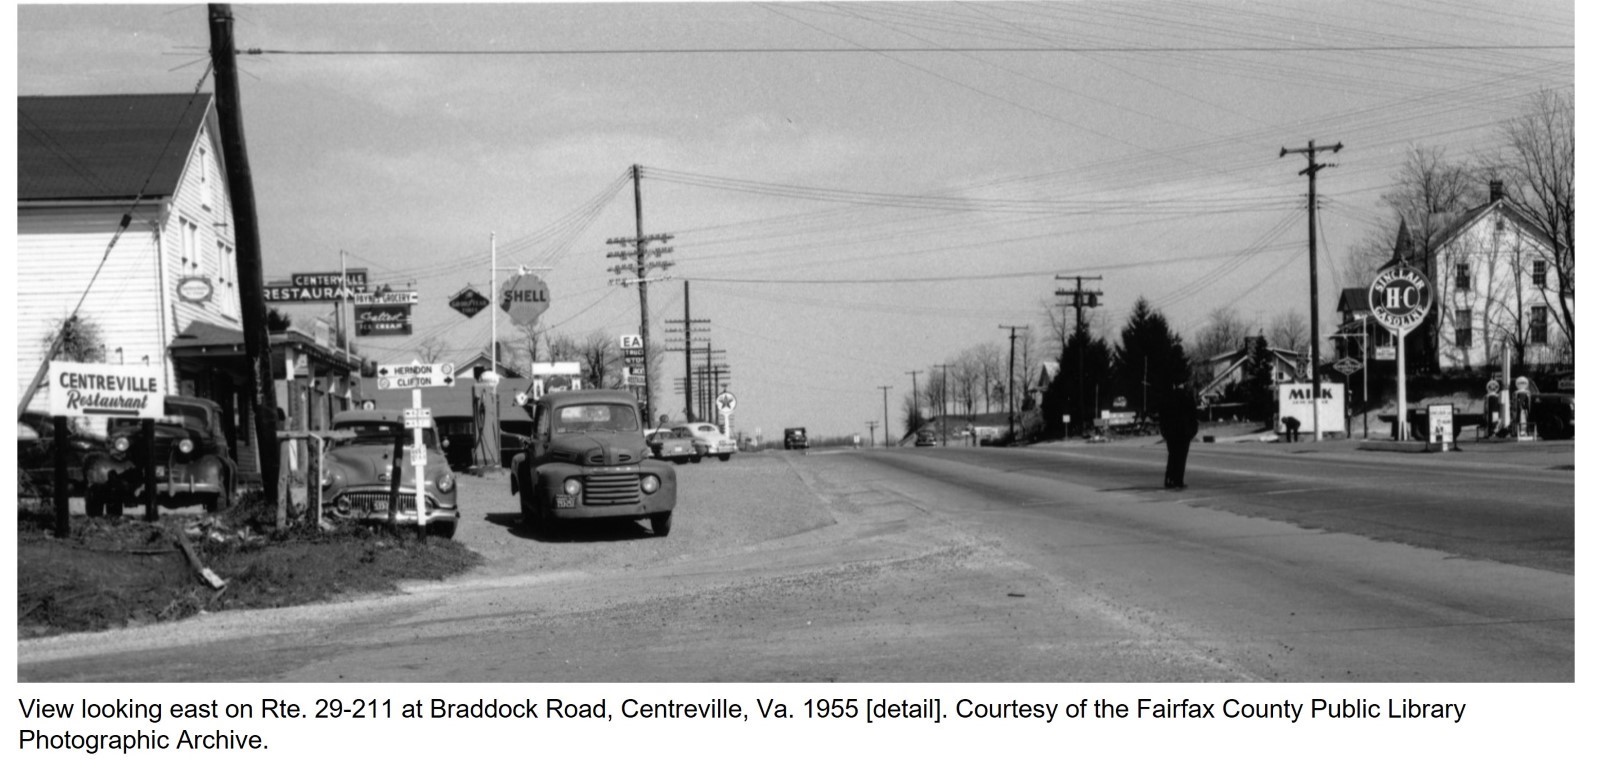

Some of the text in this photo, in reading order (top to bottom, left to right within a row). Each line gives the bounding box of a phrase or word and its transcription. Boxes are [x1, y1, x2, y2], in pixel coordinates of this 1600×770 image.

[295, 275, 364, 286] CENTERVLLE
[1375, 268, 1425, 293] SINCLAIR
[504, 290, 546, 302] SHELL
[1374, 305, 1425, 327] GASOLINE
[394, 365, 432, 375] HERNDON
[59, 371, 157, 393] CENTREVILLE
[397, 377, 432, 387] CLIFTON
[1289, 388, 1333, 399] MIK
[67, 390, 148, 411] Restaurant
